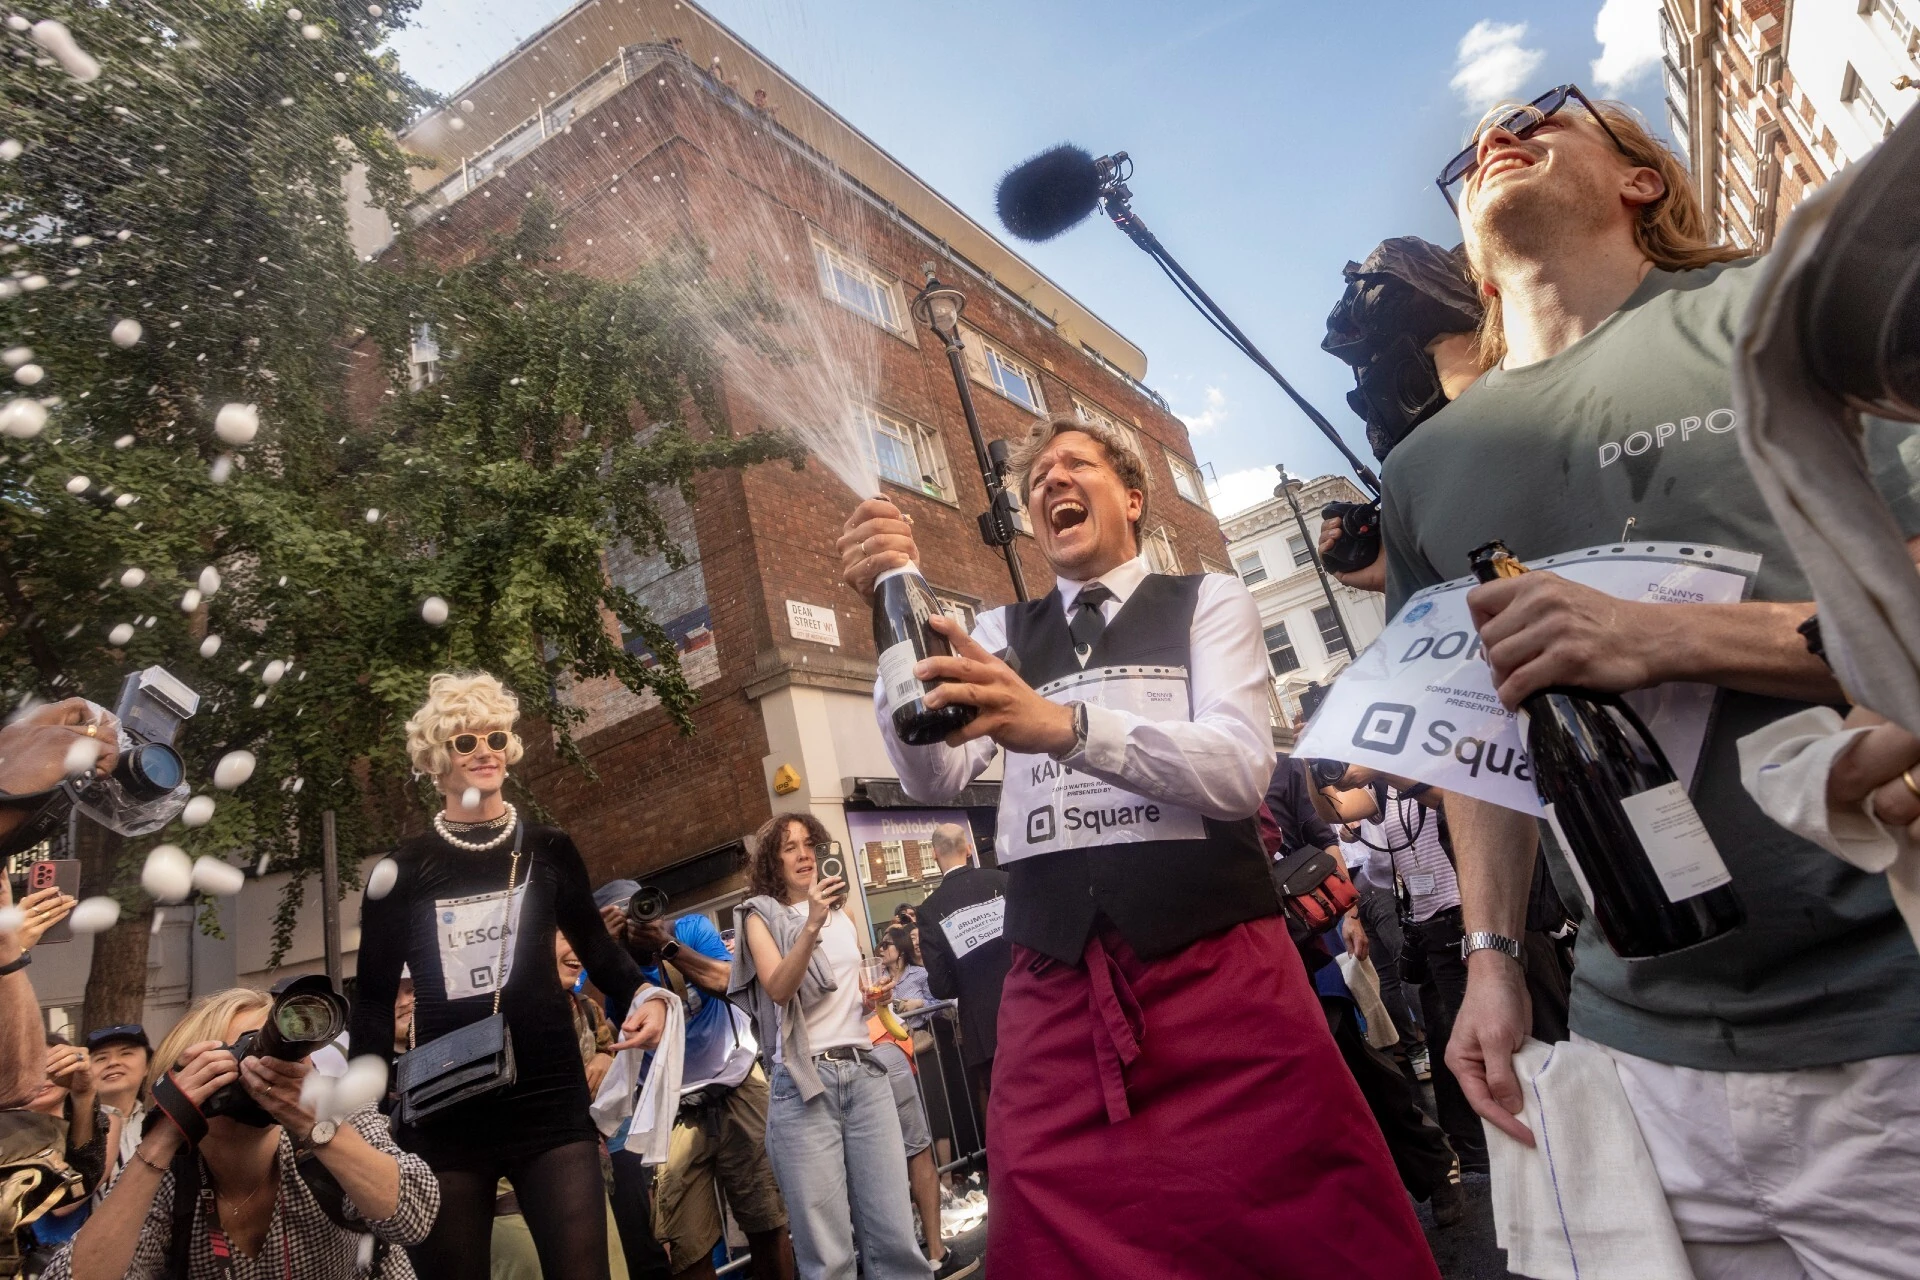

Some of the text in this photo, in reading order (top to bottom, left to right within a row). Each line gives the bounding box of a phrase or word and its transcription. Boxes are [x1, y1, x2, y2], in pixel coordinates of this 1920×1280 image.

[1598, 408, 1738, 469] DOPPO
[1647, 582, 1704, 602] DENNYS
[1651, 593, 1697, 604] BRAND
[792, 604, 813, 617] DEAN
[794, 616, 834, 633] STREET W1
[1424, 685, 1452, 694] SOHO
[1453, 688, 1497, 703] WAITERS
[1445, 697, 1505, 716] PRESENTED
[1066, 788, 1102, 797] PRESENTED
[1068, 782, 1095, 790] WAITERS
[881, 816, 939, 835] PhotoLab
[1063, 804, 1161, 834] Square
[957, 912, 992, 931] BRUMUS
